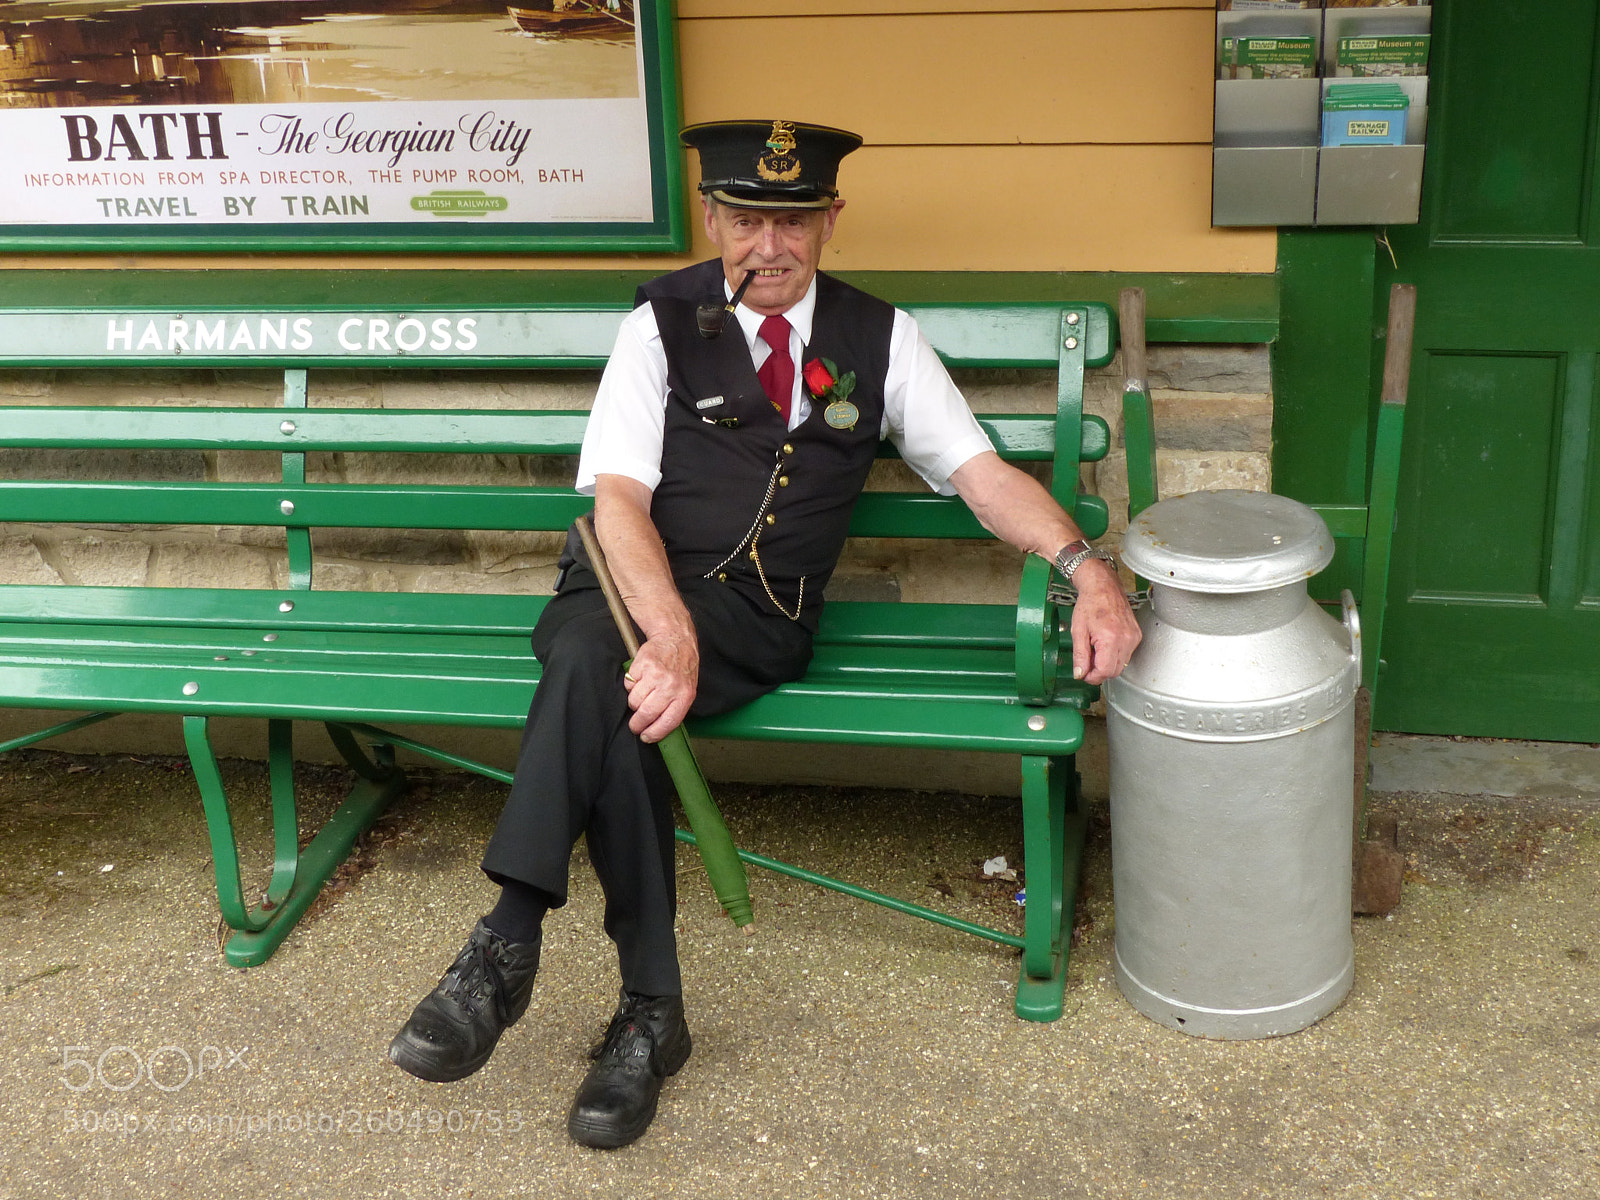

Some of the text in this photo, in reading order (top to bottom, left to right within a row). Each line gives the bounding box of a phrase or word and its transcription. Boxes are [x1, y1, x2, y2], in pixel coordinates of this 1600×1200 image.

[60, 112, 229, 162] BATH
[257, 113, 319, 155] The
[323, 111, 456, 168] Georgian
[458, 110, 532, 167] City
[24, 168, 584, 187] INFORMATION FROM SPA DIRECTOR, THE PUMP ROOM, BATH
[97, 195, 369, 217] TRAVEL BY TRAIN
[418, 199, 500, 208] BRITISH RAILWAYS
[106, 318, 478, 351] HARMANS CROSS
